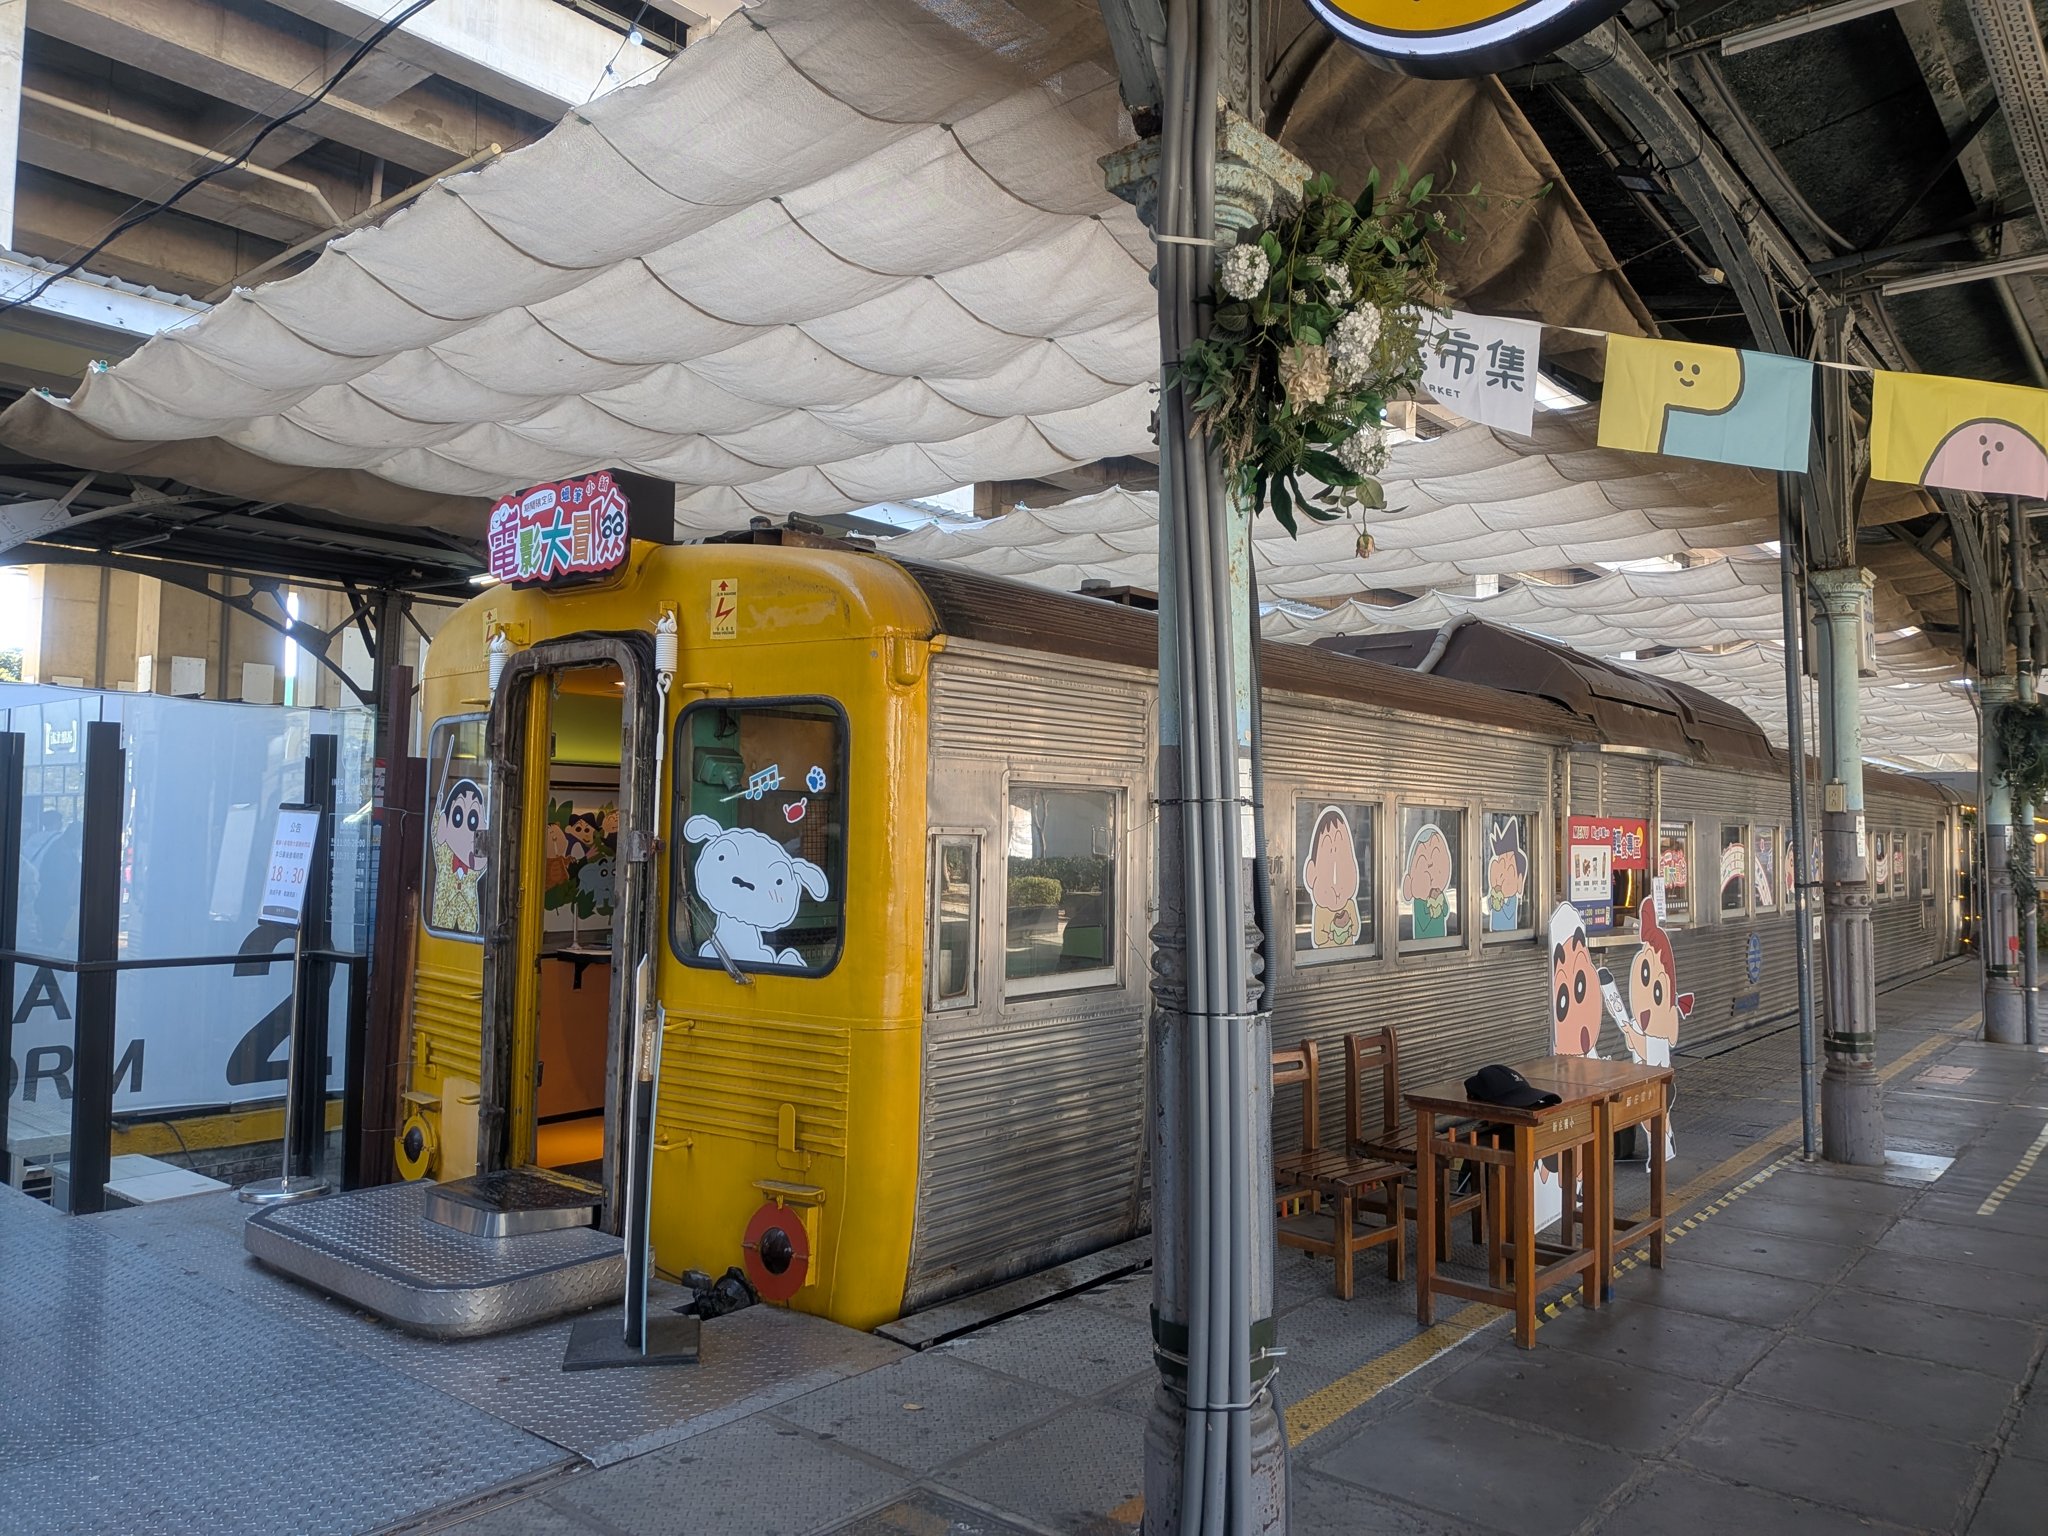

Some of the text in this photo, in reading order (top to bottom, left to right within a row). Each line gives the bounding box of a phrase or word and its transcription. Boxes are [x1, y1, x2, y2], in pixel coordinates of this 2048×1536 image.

[1415, 329, 1526, 393] 市集
[489, 489, 625, 578] 電影大冒險
